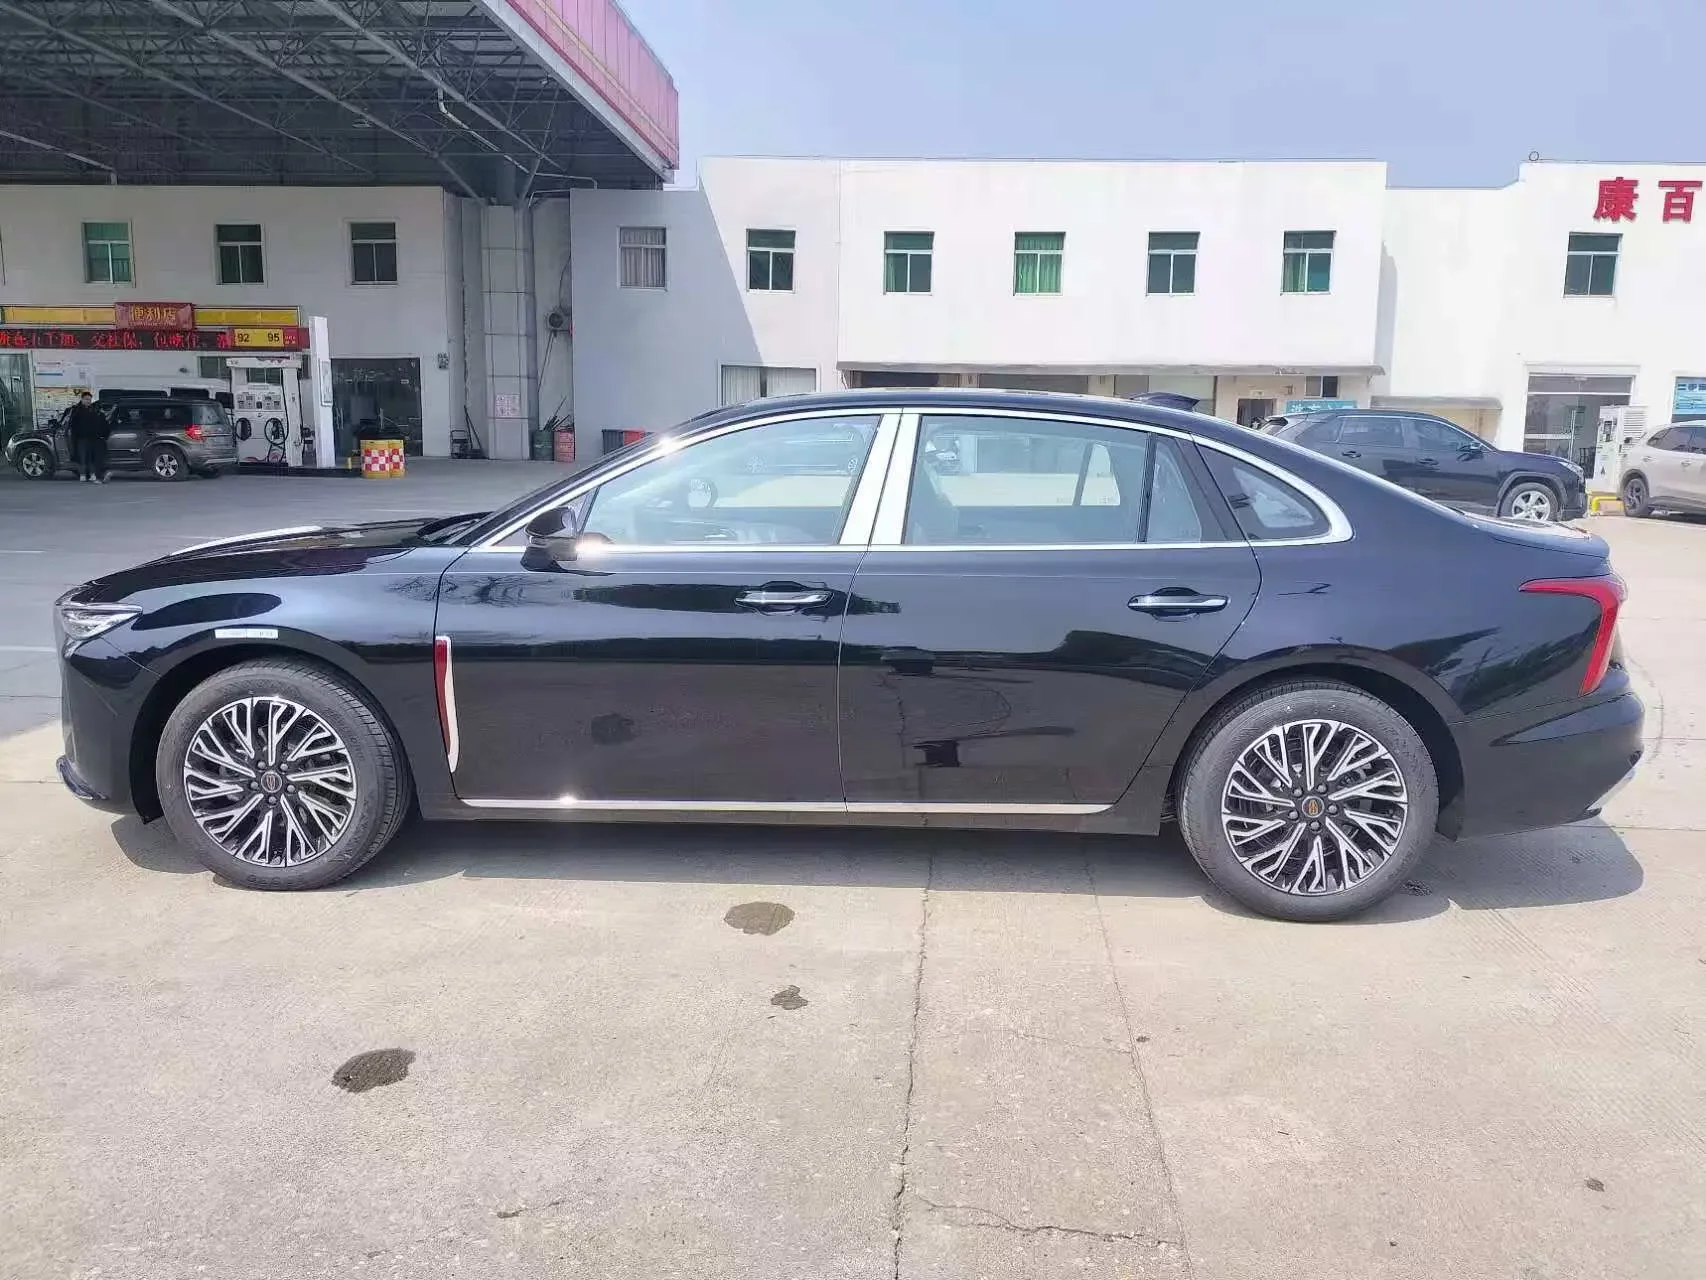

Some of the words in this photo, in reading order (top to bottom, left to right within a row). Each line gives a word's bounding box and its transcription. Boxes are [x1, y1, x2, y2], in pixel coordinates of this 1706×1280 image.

[1593, 177, 1703, 222] 康百
[131, 304, 177, 321] 便利店
[237, 332, 250, 343] 92
[267, 332, 280, 343] 95
